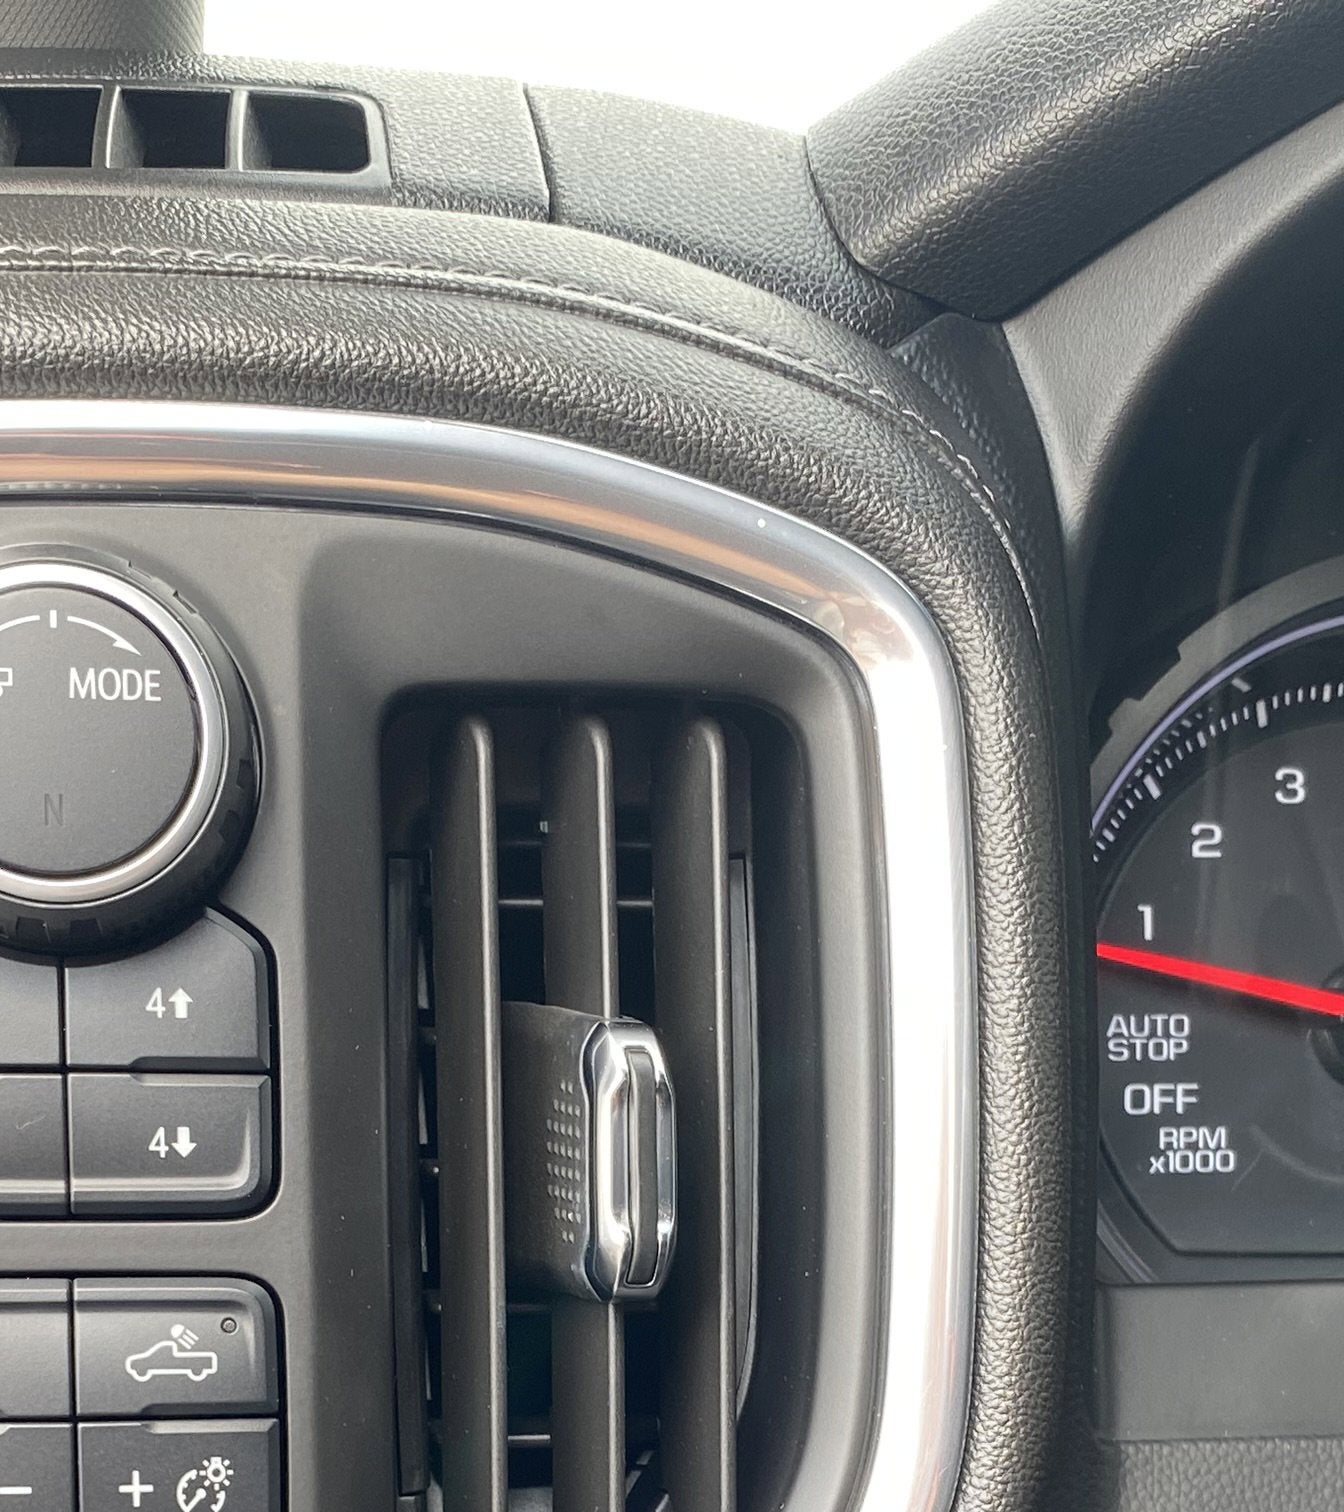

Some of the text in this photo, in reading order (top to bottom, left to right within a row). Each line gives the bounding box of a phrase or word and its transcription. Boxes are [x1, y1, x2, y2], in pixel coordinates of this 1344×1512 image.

[68, 667, 162, 702] MODE
[1274, 768, 1306, 804] 3
[43, 793, 64, 827] N
[1191, 823, 1223, 858] 2
[1137, 904, 1154, 941] 1
[145, 988, 166, 1019] 4
[1106, 1013, 1190, 1038] AUTO
[1107, 1038, 1189, 1062] STOP
[1123, 1083, 1199, 1116] OFF
[148, 1127, 170, 1159] 4
[1158, 1127, 1227, 1151] RPM
[1149, 1150, 1236, 1174] x1000
